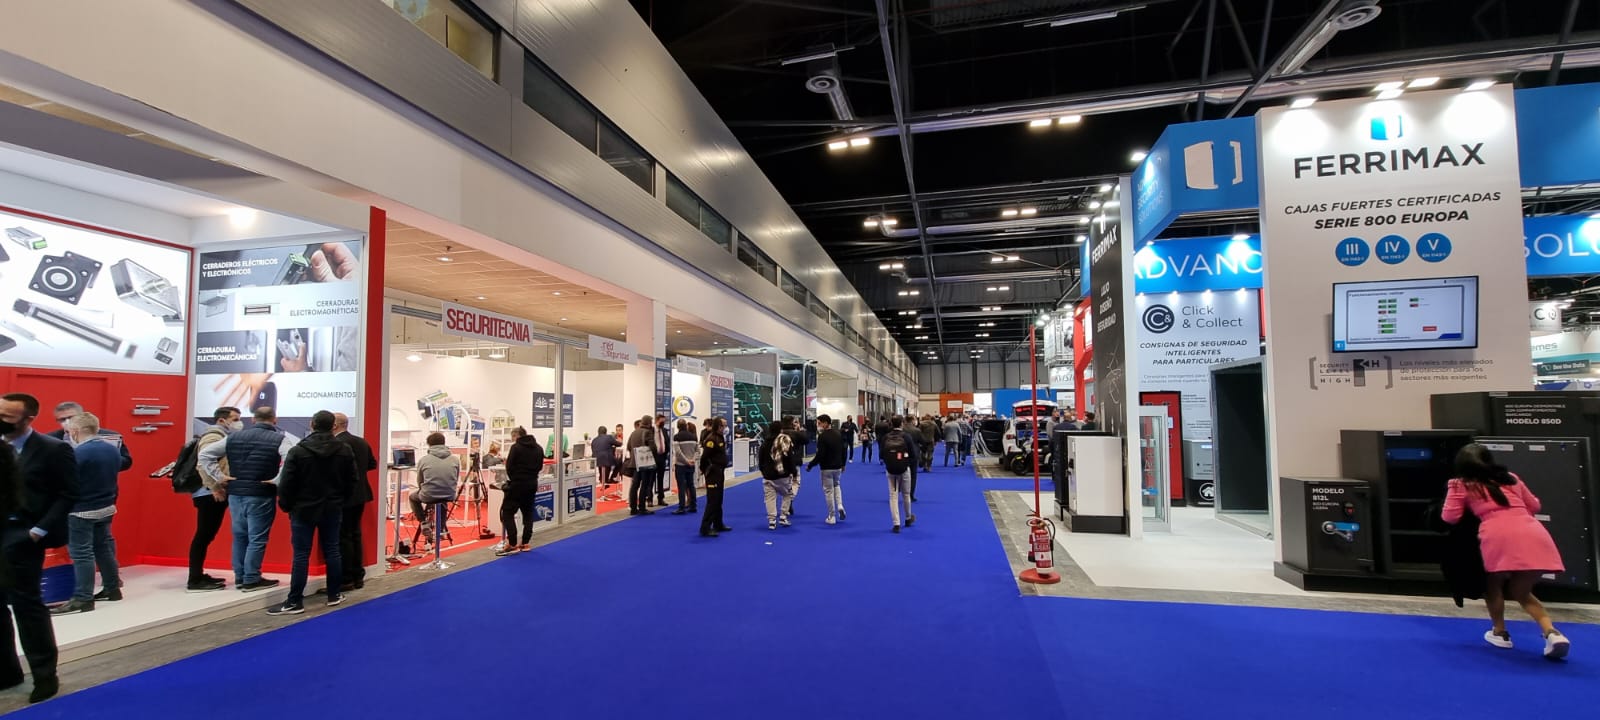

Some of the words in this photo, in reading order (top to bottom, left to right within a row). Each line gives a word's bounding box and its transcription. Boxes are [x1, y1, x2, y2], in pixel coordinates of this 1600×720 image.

[1294, 142, 1485, 179] FERRIMAX
[1284, 204, 1328, 214] CAJAS
[1331, 199, 1392, 211] FUERTES
[1397, 192, 1501, 207] CERTIFICADAS
[1314, 217, 1360, 229] SERIE
[1364, 215, 1396, 226] 800
[1401, 211, 1469, 224] EUROPA
[1092, 224, 1117, 266] FERRIMAX
[1346, 243, 1359, 255] III
[1385, 241, 1400, 253] IV
[1428, 239, 1439, 251] V
[202, 260, 240, 270] CERRADEROS
[242, 258, 278, 267] ELÉCTRICOS
[208, 268, 251, 277] ELECTRÓNICOS
[316, 299, 358, 307] CERRADURAS
[290, 306, 358, 317] ELECTROMAGNÉTICAS
[1182, 306, 1214, 316] Click
[446, 308, 530, 343] SEGURITECNIA
[1182, 319, 1191, 328] &
[1196, 318, 1243, 328] Collect
[197, 353, 257, 361] ELECTROMECÁNICAS
